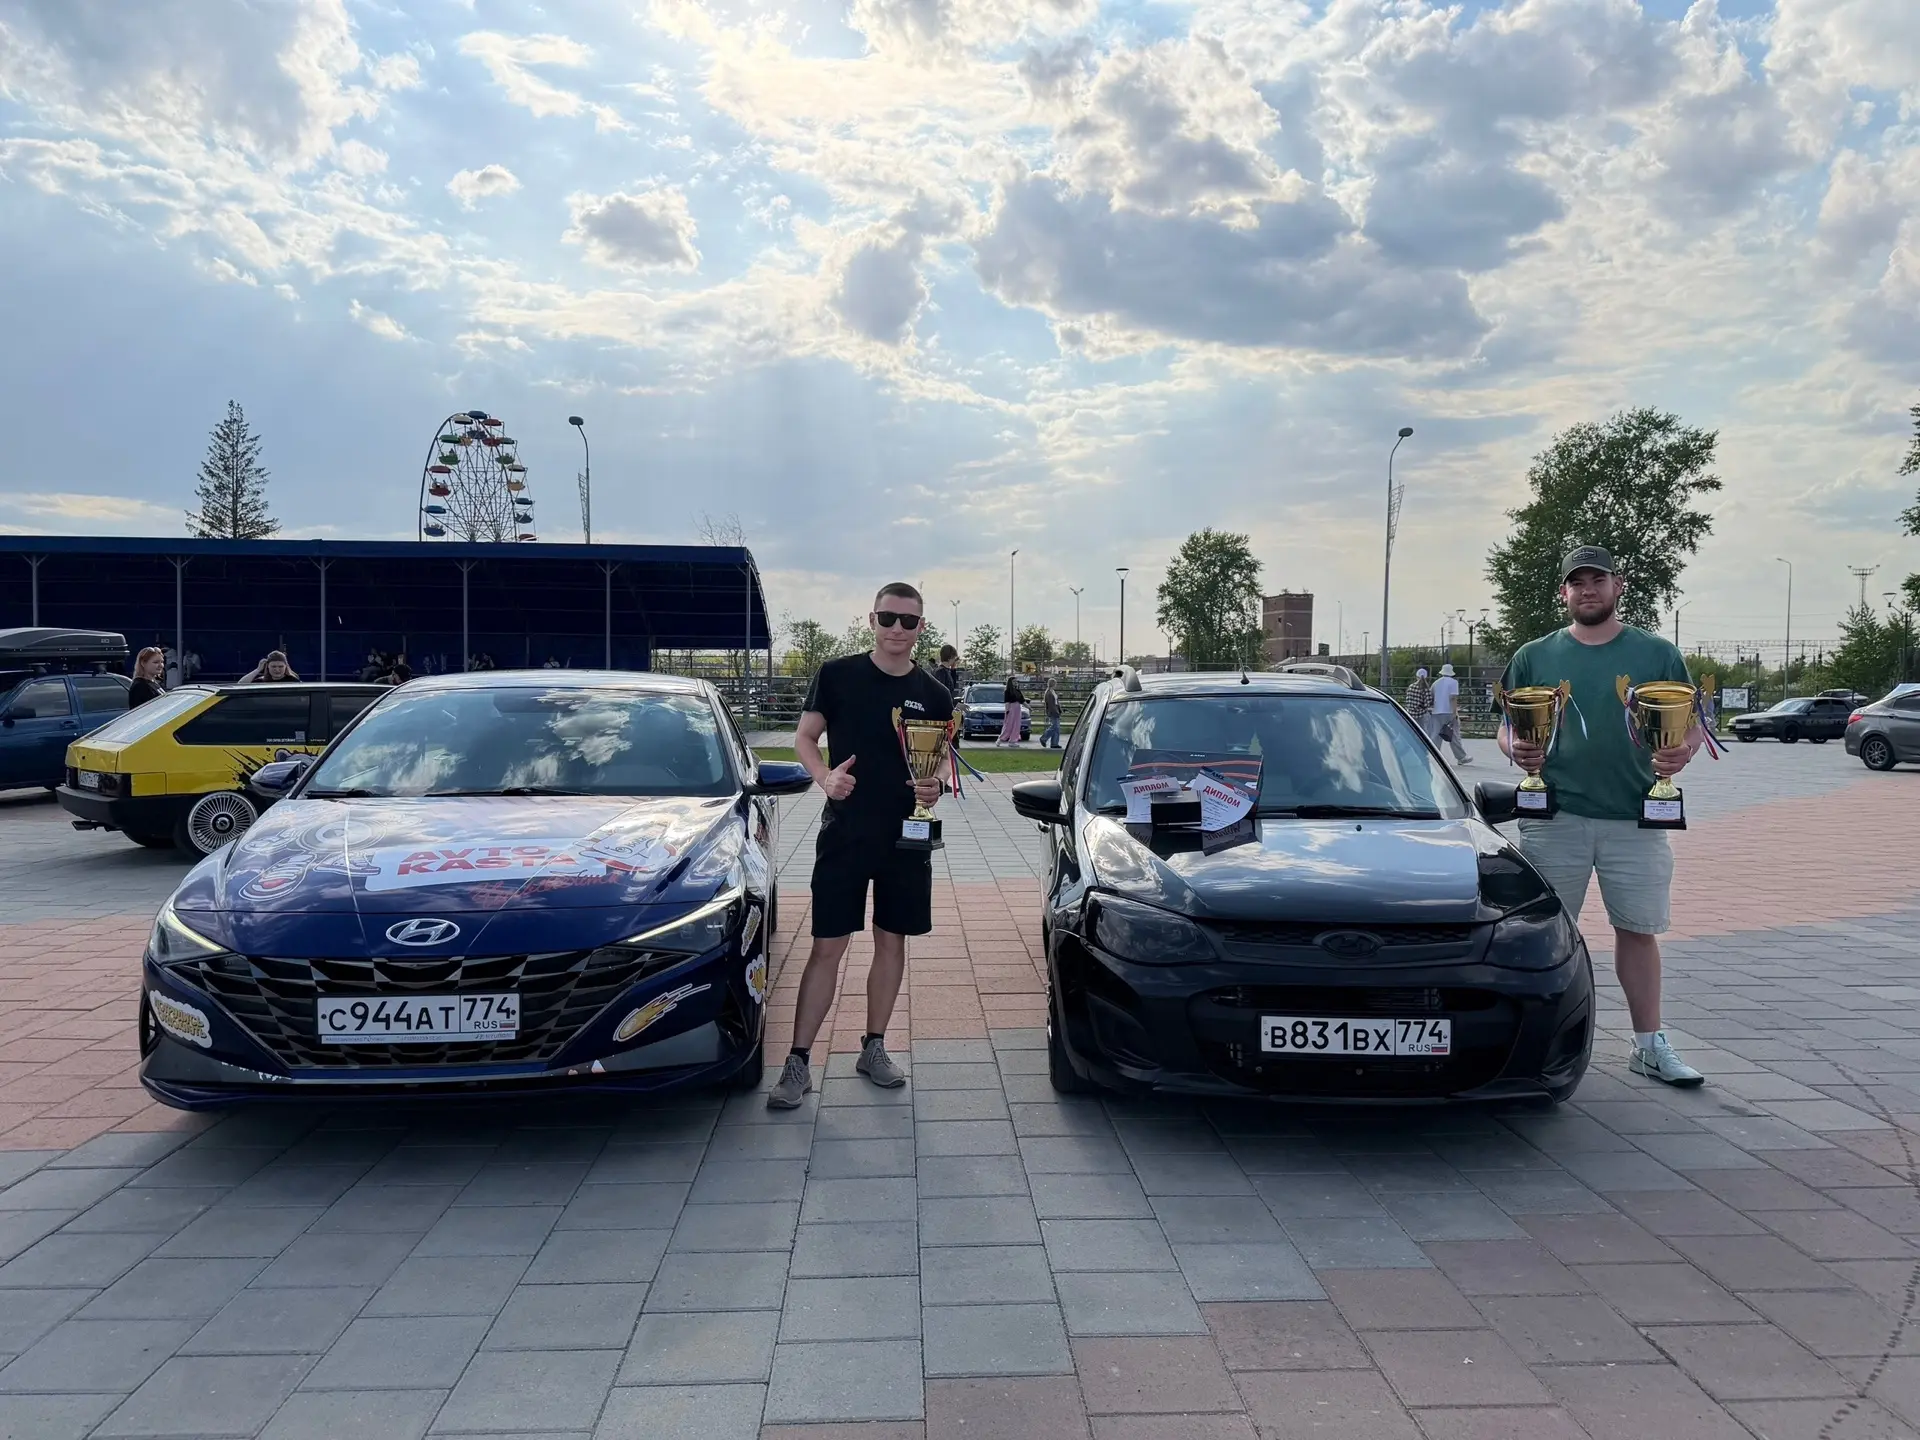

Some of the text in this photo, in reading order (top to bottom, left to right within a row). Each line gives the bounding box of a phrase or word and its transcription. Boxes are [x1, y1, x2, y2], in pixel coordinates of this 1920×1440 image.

[1133, 781, 1170, 794] ДИПЛОМ
[1202, 785, 1241, 808] ДИПЛОМ
[400, 845, 551, 863] AVTO
[396, 853, 581, 876] KASTA
[462, 996, 511, 1021] 774
[473, 1020, 498, 1029] RUS
[1397, 1020, 1443, 1044] 774
[1408, 1043, 1431, 1053] RUS
